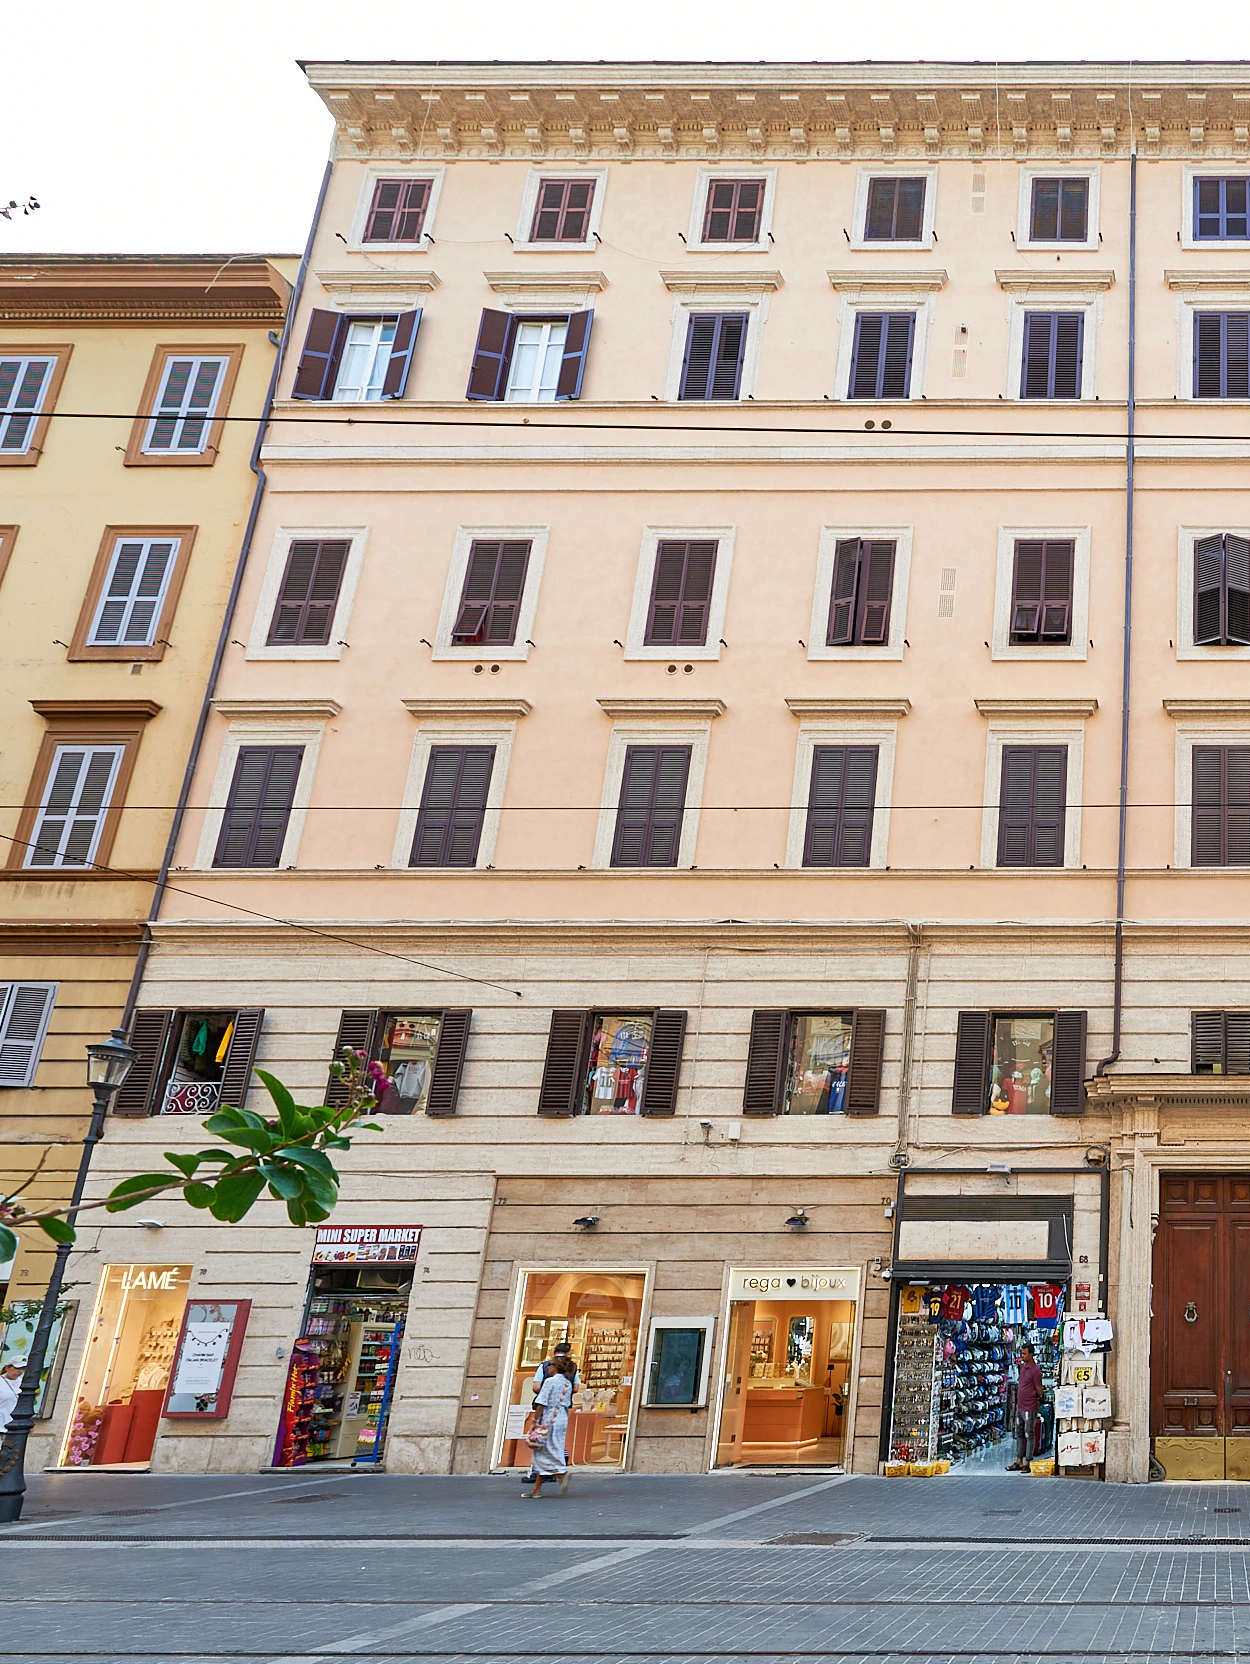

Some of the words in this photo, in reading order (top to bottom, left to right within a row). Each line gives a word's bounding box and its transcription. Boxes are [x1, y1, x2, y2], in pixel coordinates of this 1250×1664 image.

[881, 1197, 892, 1205] 70
[316, 1228, 342, 1243] MINI
[343, 1228, 378, 1243] SUPER
[378, 1228, 422, 1243] MARKET
[121, 1266, 180, 1290] LAMÉ
[743, 1277, 781, 1293] rega
[801, 1274, 846, 1292] bijoux
[951, 1294, 962, 1310] 21
[1009, 1294, 1022, 1310] 10
[1038, 1292, 1053, 1309] 10
[929, 1302, 941, 1316] 19
